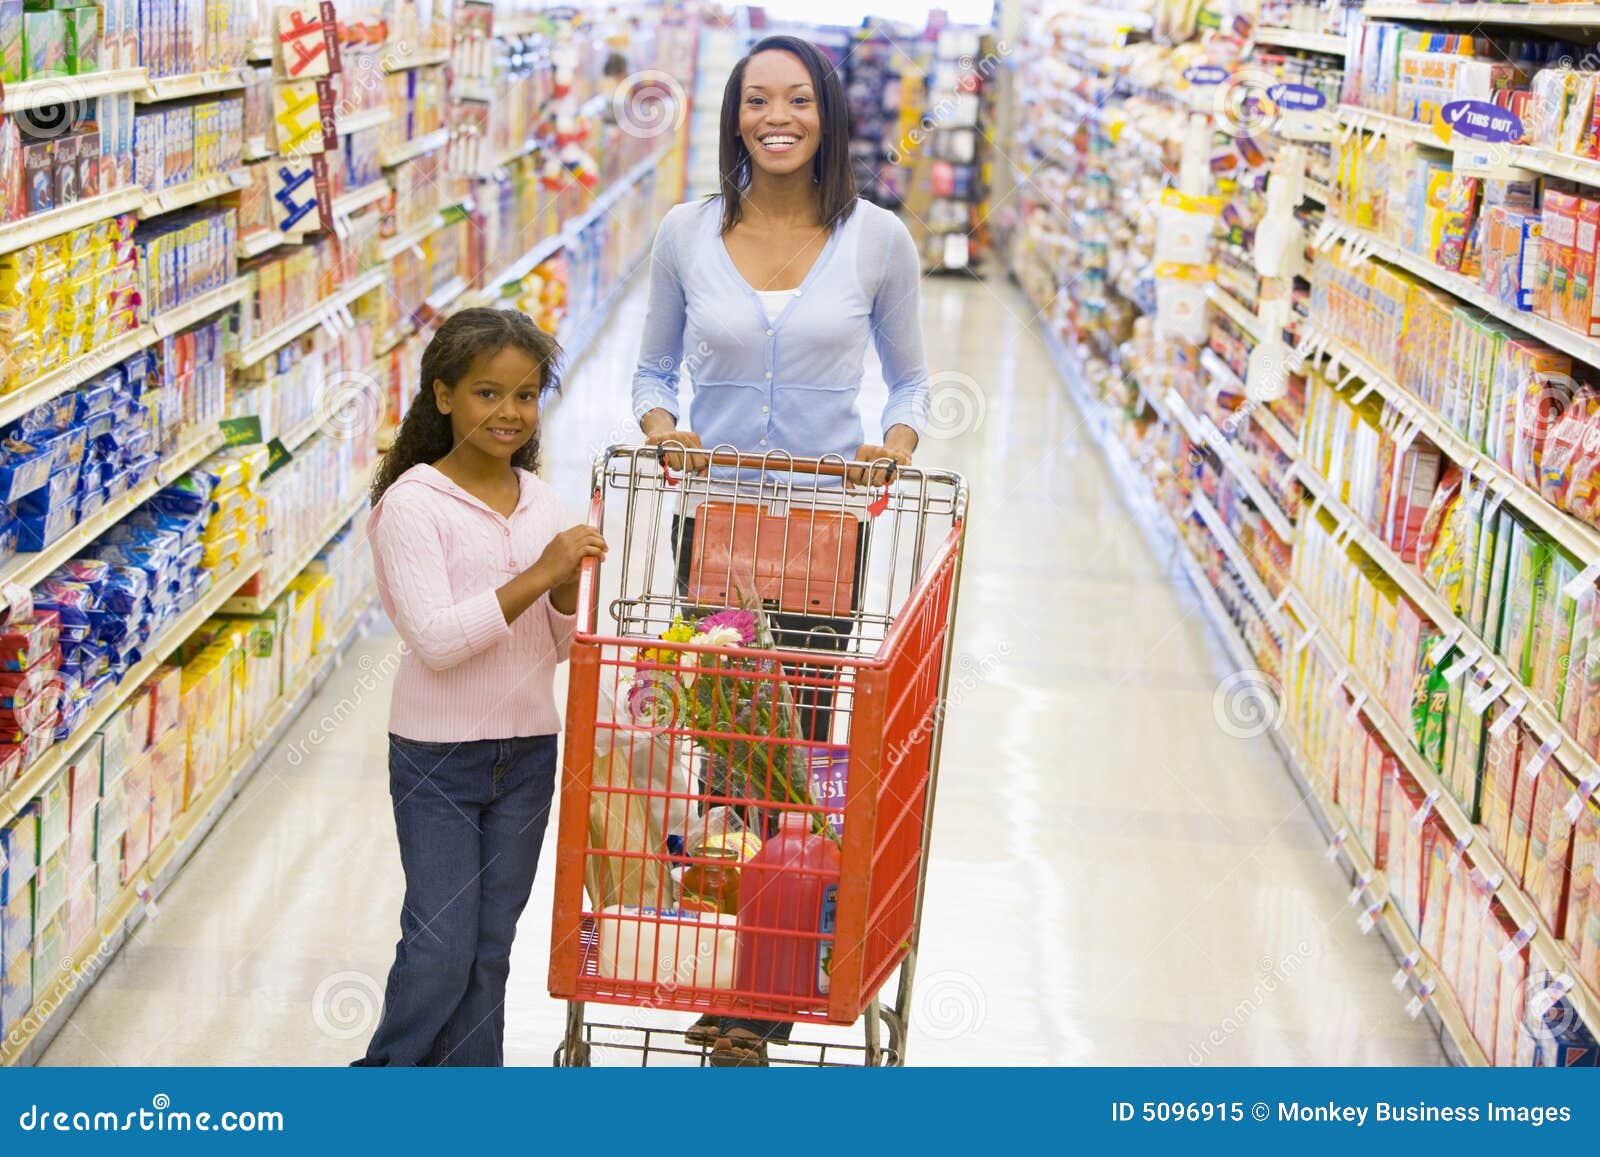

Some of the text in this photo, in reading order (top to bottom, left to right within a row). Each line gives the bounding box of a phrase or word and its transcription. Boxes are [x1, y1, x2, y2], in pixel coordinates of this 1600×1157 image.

[1466, 111, 1513, 133] THIS OUT
[812, 772, 848, 799] isi
